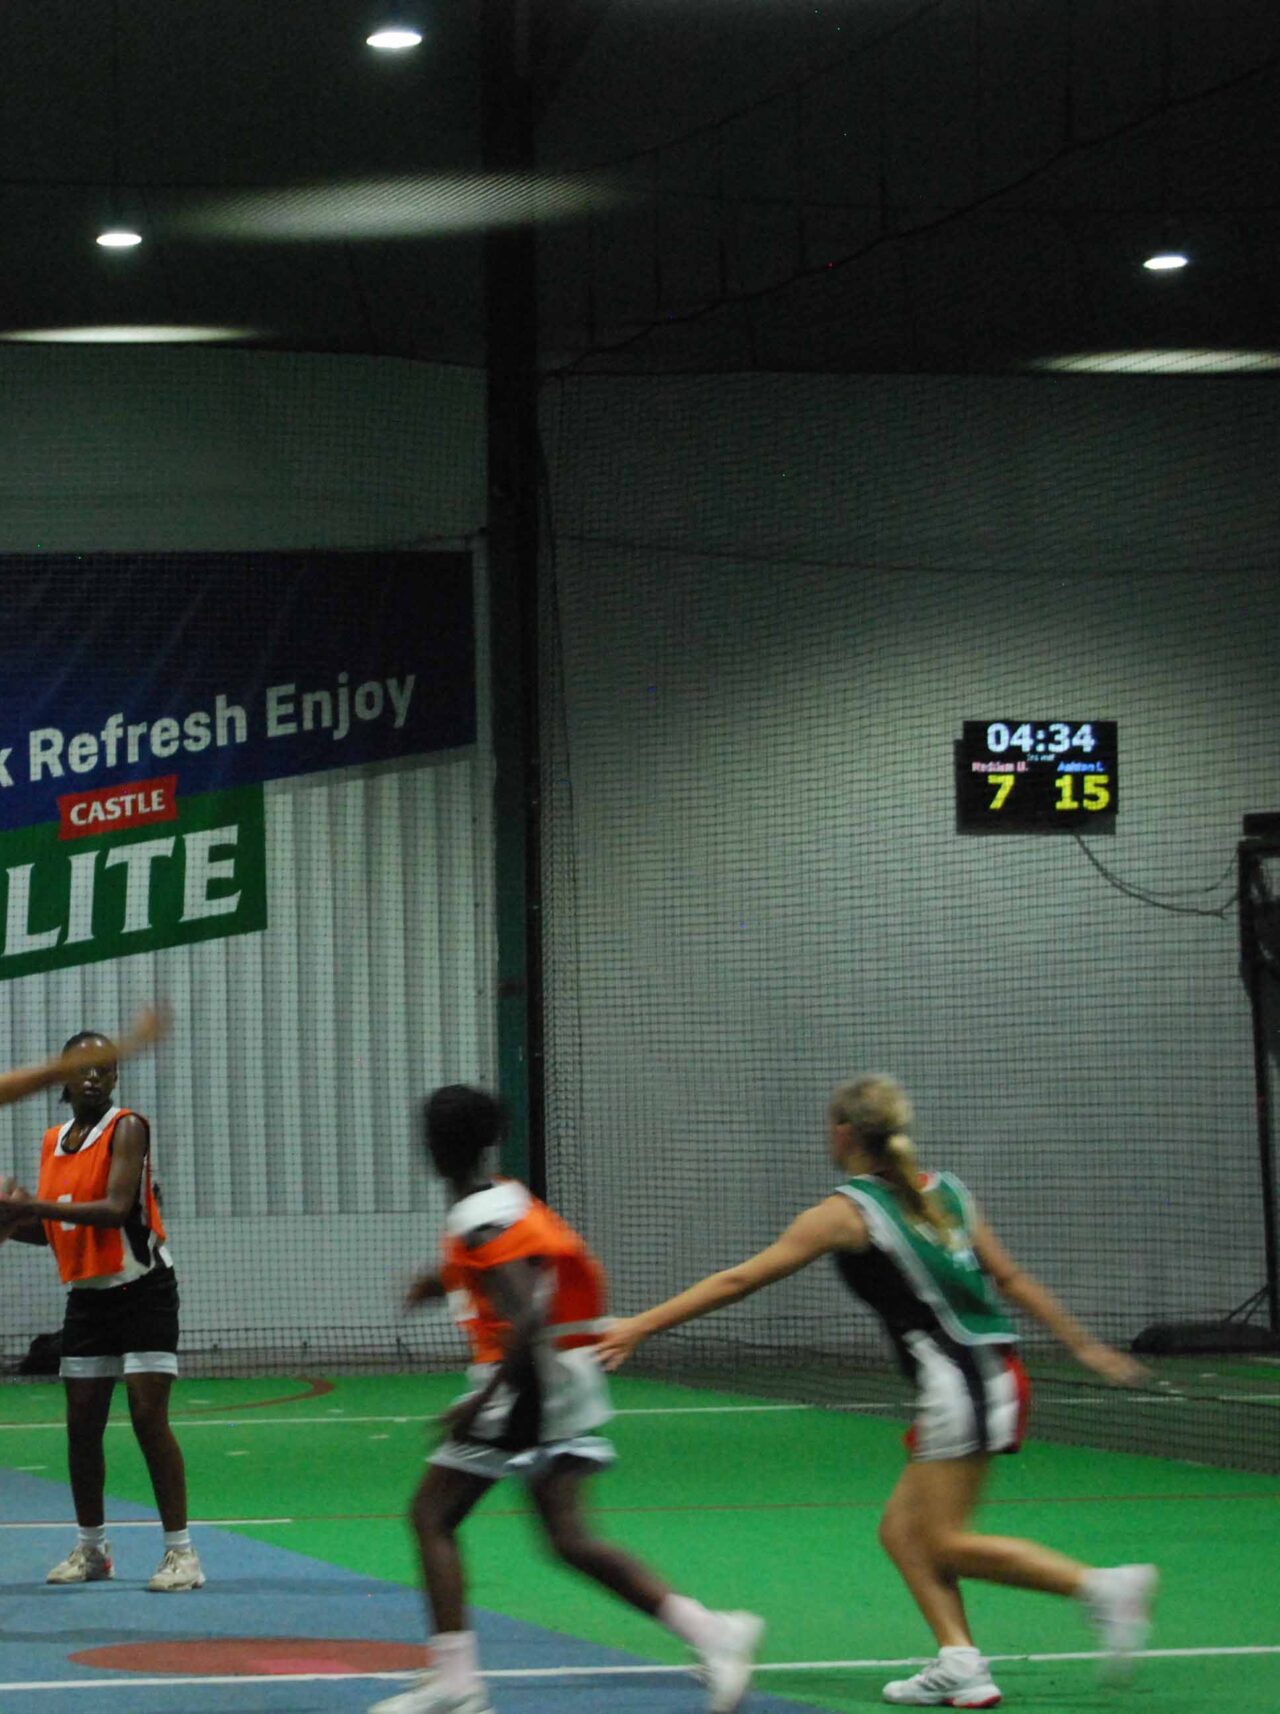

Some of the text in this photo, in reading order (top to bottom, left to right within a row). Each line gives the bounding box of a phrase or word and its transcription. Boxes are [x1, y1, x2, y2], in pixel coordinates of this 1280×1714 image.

[29, 694, 248, 782] Refresh
[266, 671, 416, 741] Enjoy
[987, 722, 1096, 753] 04:34
[70, 789, 166, 826] CASTLE
[987, 774, 1015, 810] 7
[1055, 774, 1110, 811] 15
[1, 824, 242, 958] LITE
